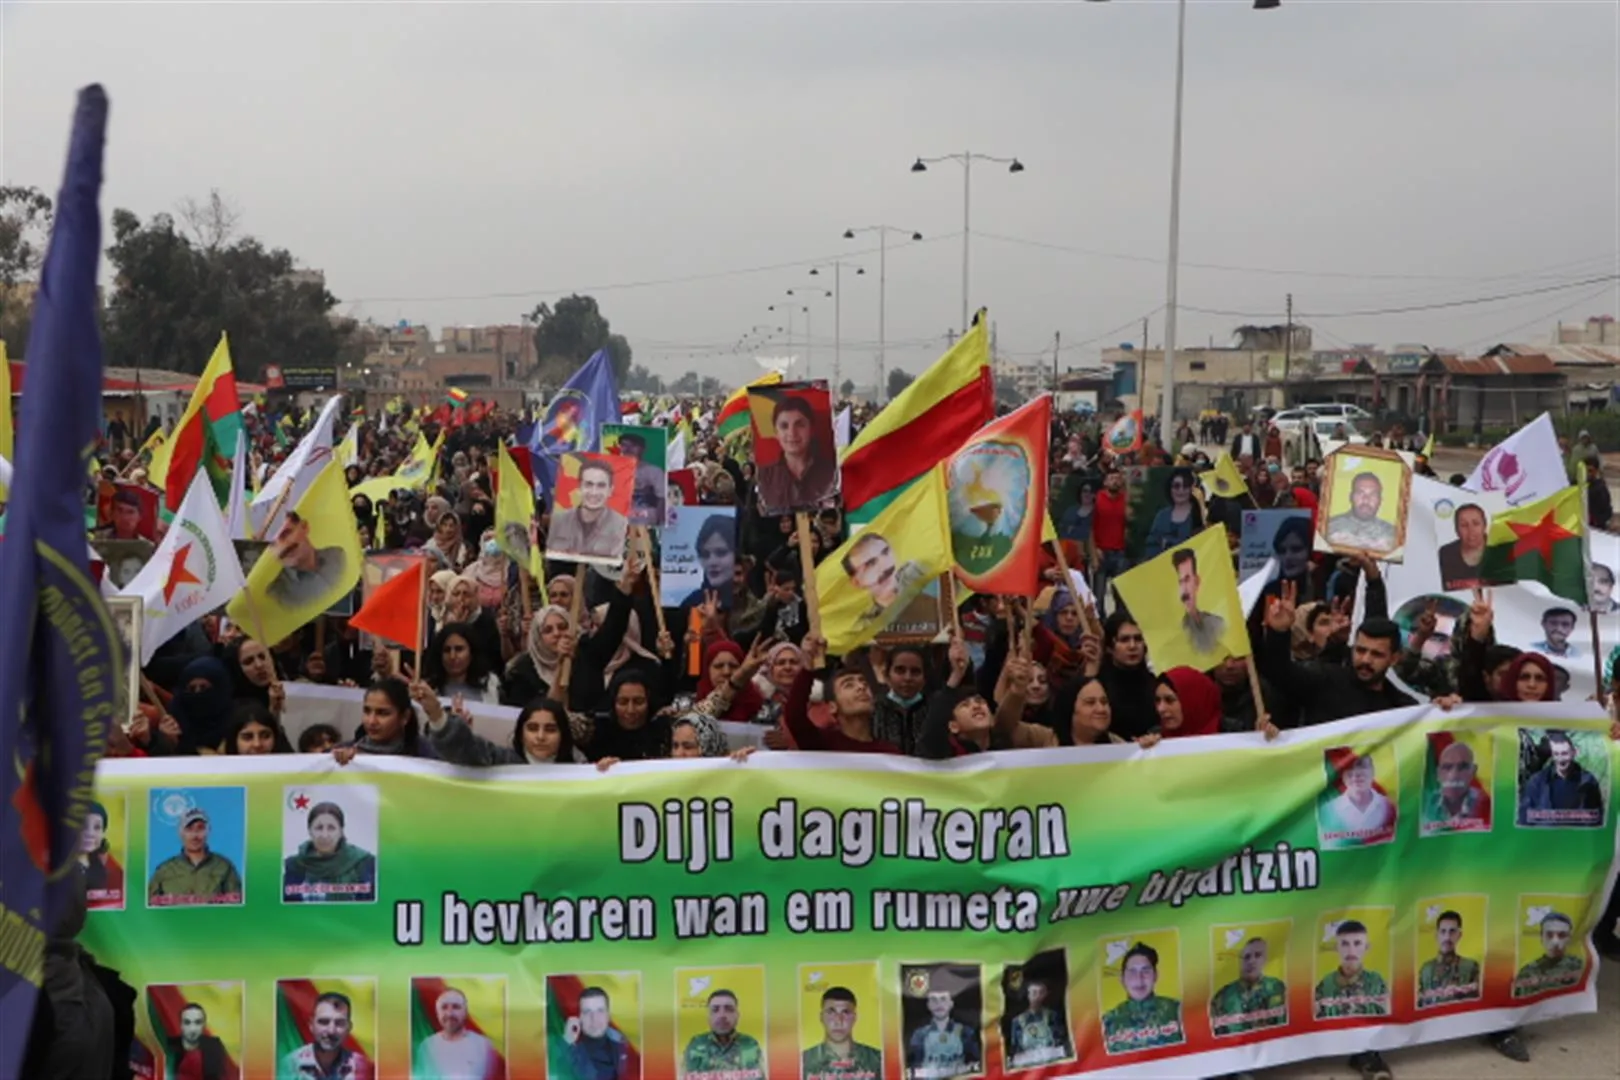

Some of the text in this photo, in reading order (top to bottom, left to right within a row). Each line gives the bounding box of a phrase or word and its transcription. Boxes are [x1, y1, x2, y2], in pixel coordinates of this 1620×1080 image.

[619, 797, 1070, 873] Diji dagikeran
[395, 842, 1320, 946] u hevkaren wan em rumeta xwe biparizin
